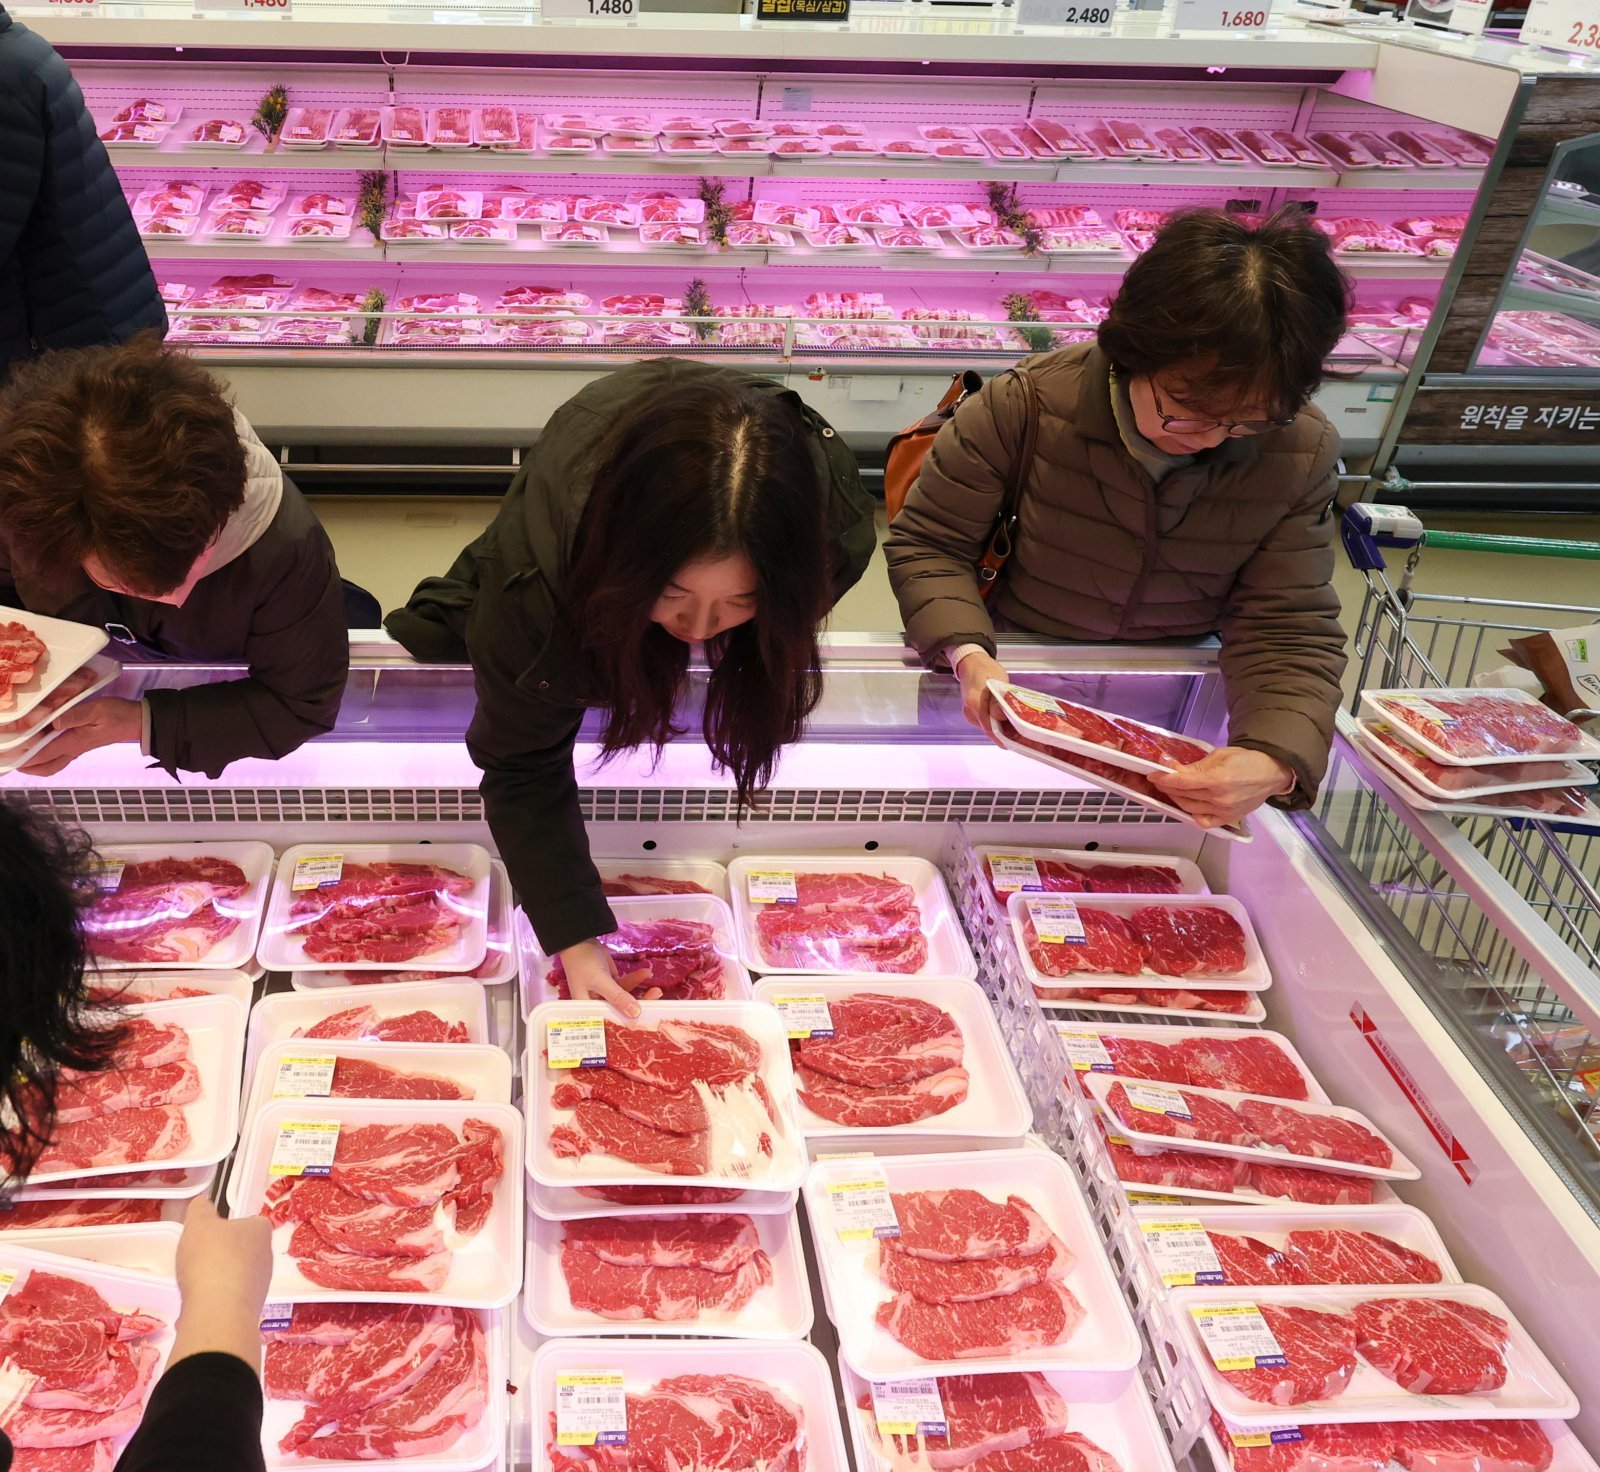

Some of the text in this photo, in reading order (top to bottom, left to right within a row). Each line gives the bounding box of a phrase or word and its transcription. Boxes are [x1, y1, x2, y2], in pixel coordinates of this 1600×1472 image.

[587, 0, 633, 15] 1,480
[1065, 7, 1110, 25] 2,480
[1220, 10, 1265, 27] 1,680
[1460, 405, 1600, 430] 원칙을 지키는
